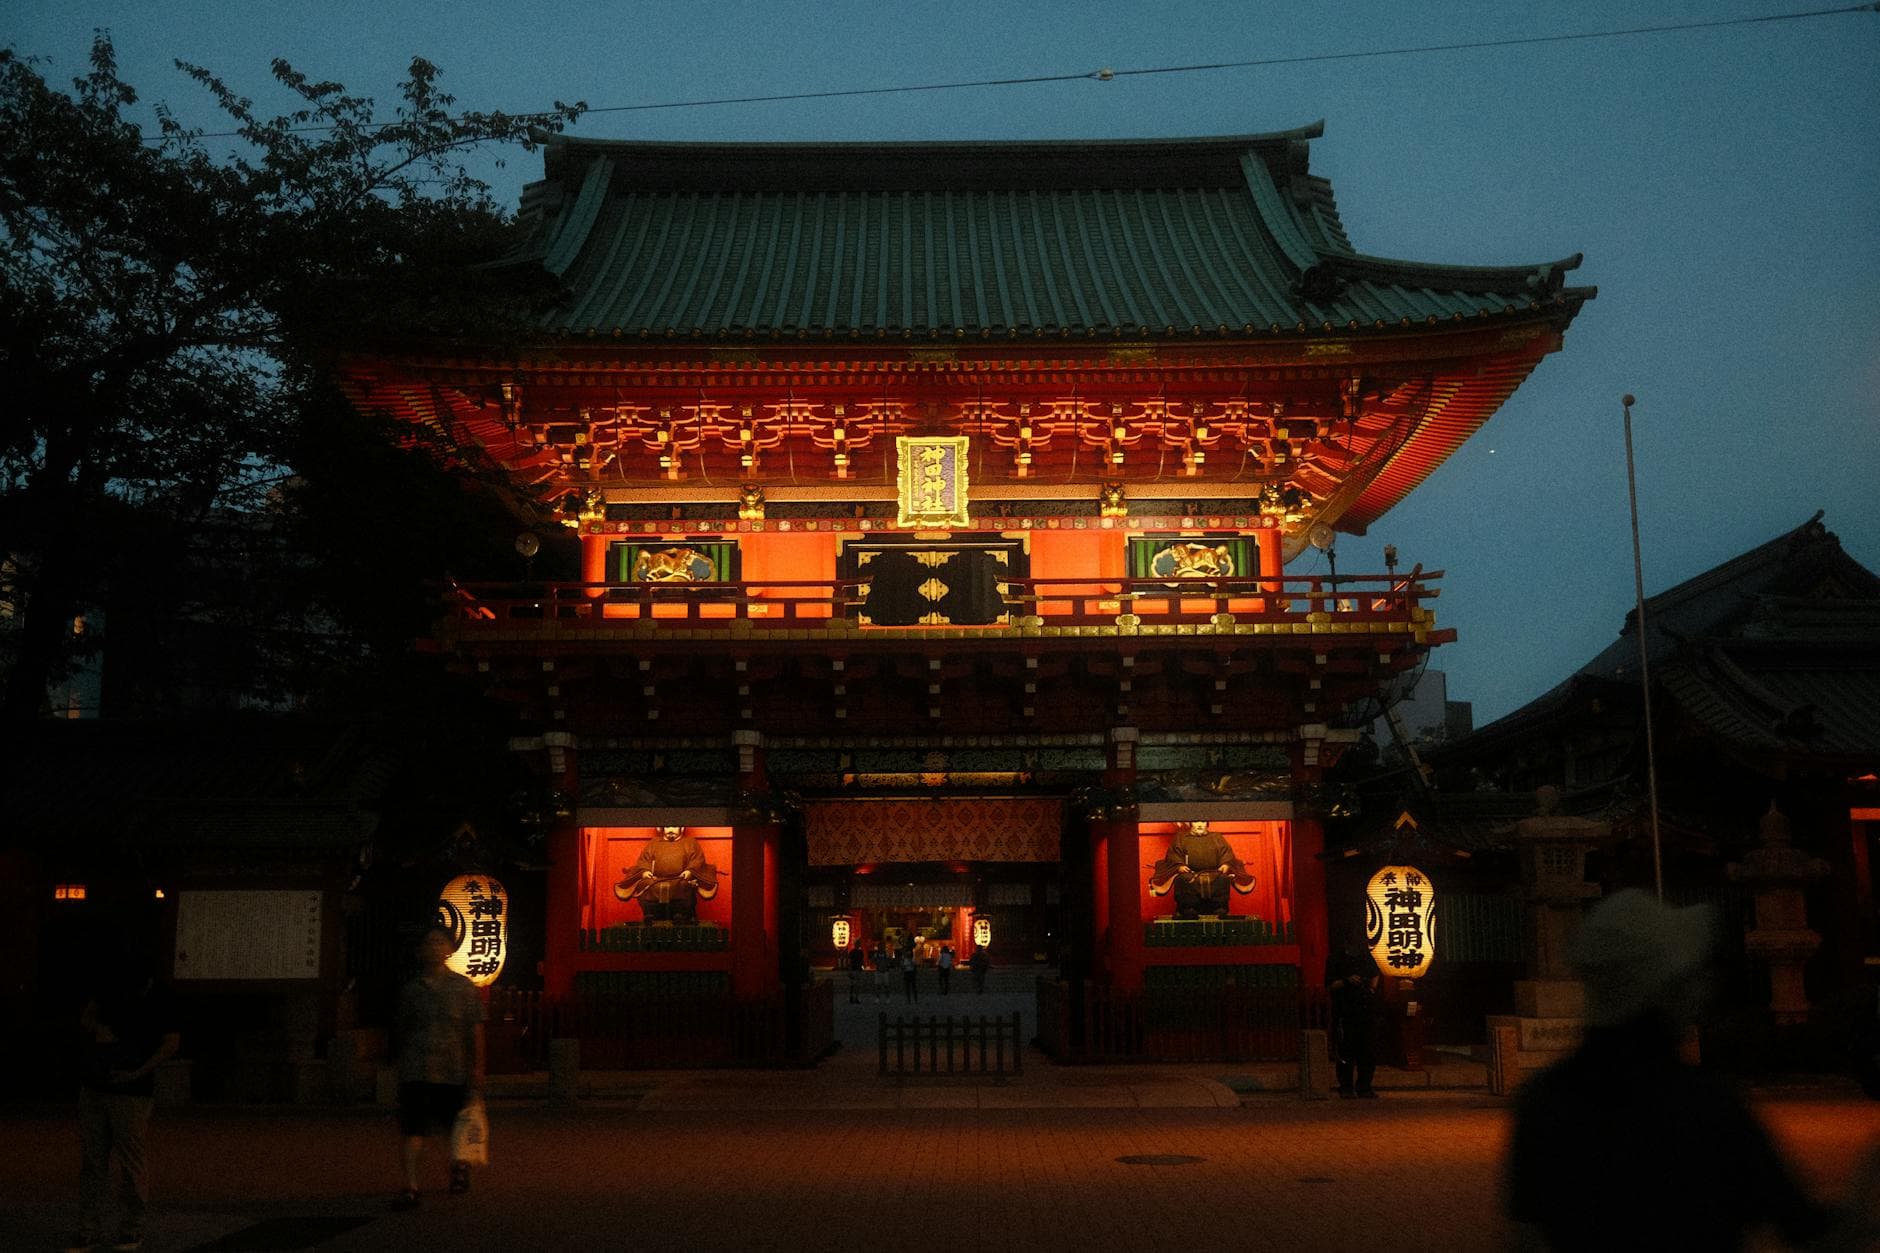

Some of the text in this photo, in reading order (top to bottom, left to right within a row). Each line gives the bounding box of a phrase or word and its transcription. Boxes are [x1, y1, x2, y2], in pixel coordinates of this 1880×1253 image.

[920, 446, 946, 511] 神田神社
[465, 894, 503, 977] 神田明神
[1384, 887, 1424, 969] 神田明神
